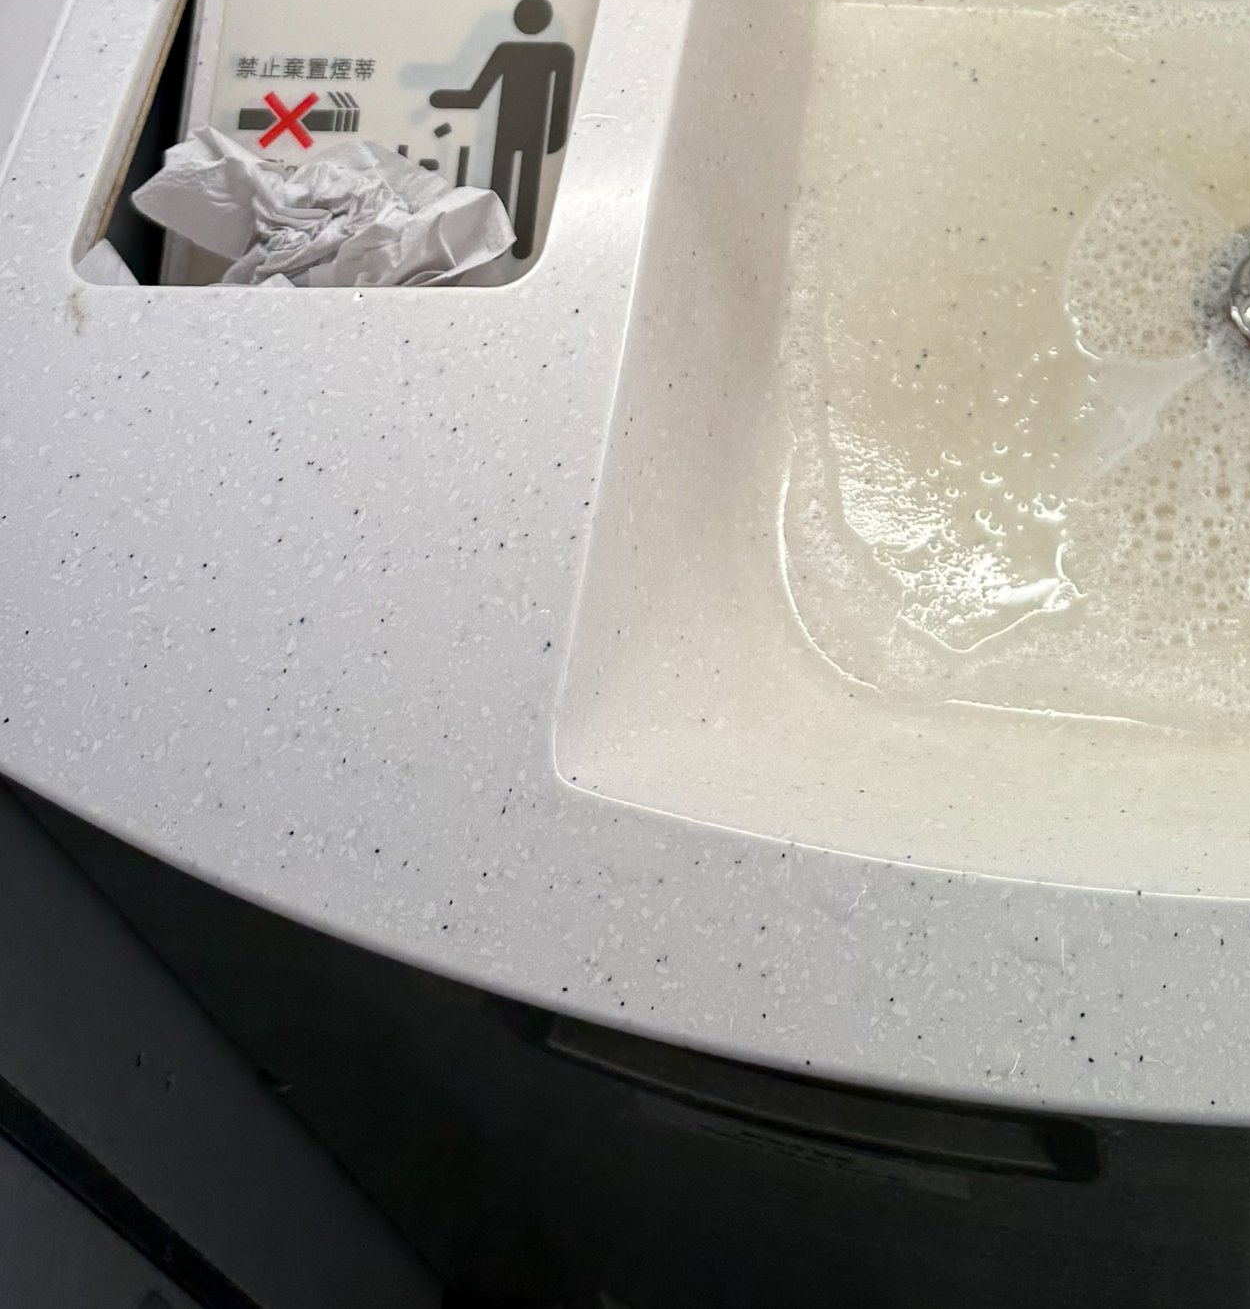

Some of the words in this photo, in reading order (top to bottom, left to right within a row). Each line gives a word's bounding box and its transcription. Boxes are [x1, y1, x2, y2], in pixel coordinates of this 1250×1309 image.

[235, 57, 377, 81] 禁止棄置煙蒂
